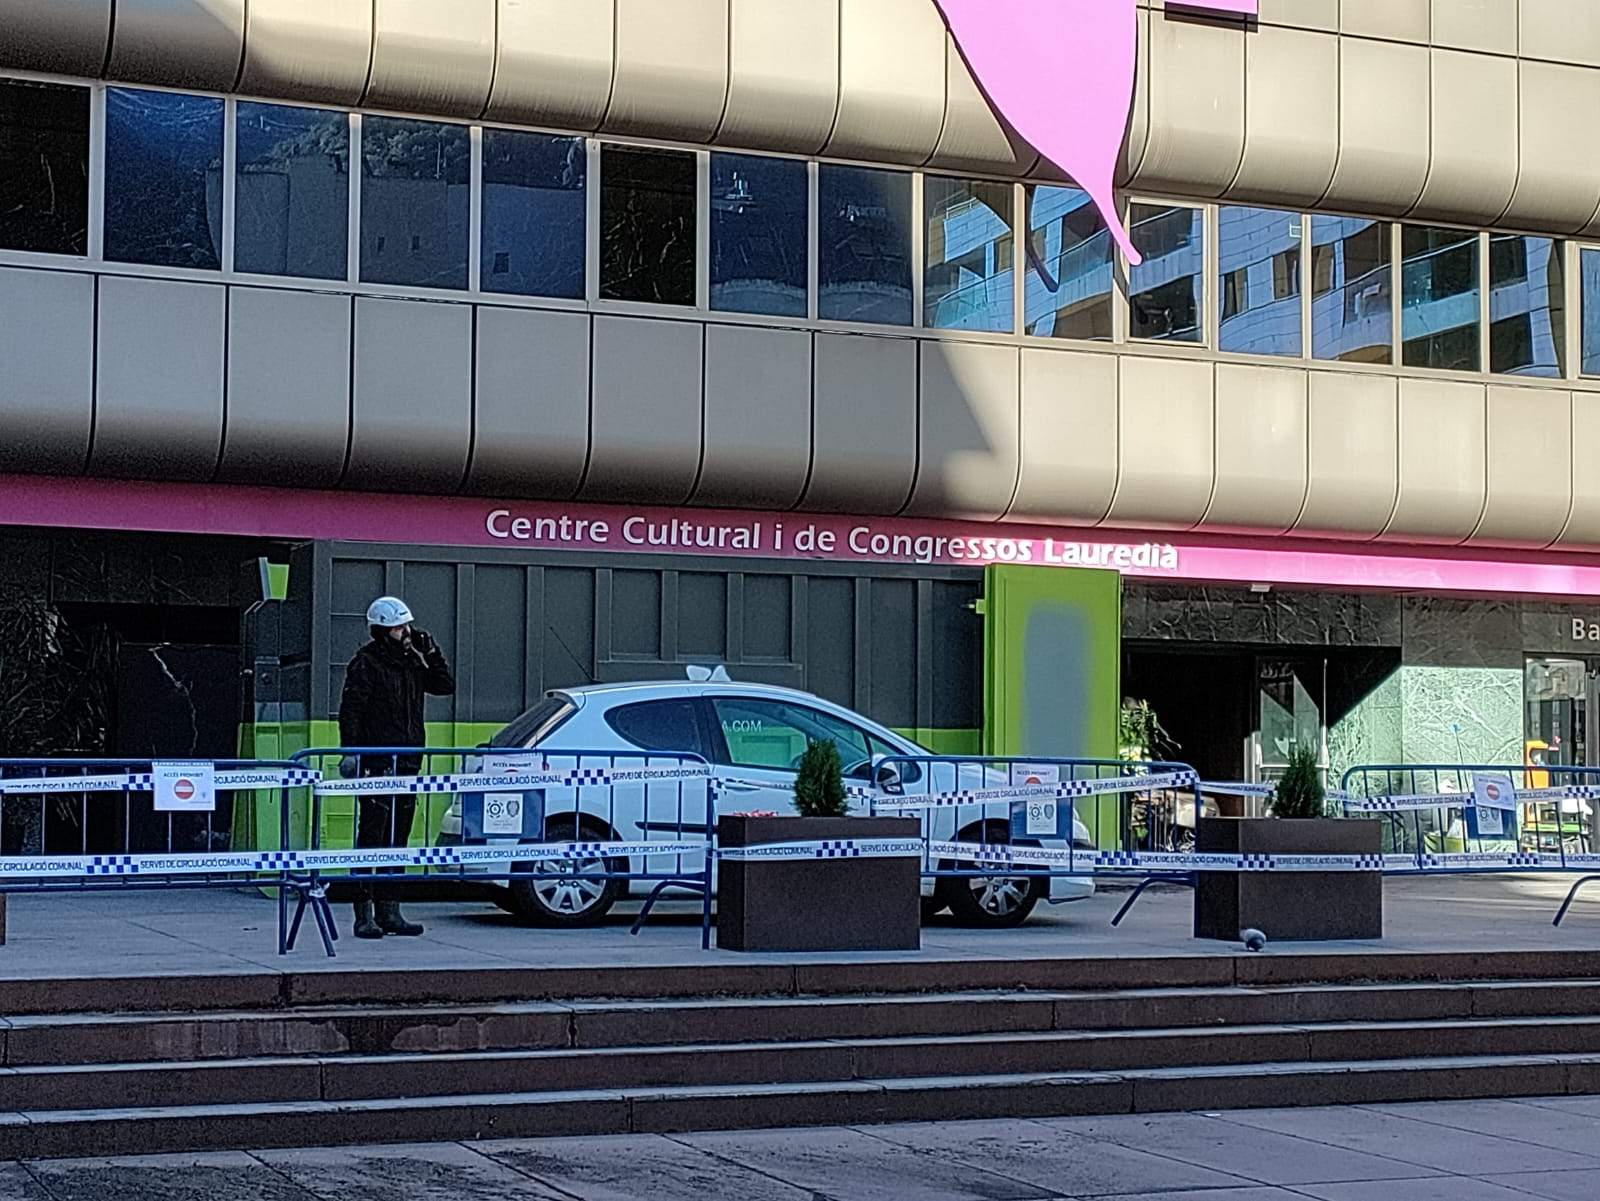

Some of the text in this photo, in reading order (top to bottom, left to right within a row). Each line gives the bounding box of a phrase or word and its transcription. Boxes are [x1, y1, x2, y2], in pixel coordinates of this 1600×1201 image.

[485, 509, 1178, 569] Centre Cultural i de Congressos Lauredià
[1572, 618, 1600, 641] Ba
[460, 777, 482, 786] SERVEI
[483, 777, 491, 785] DE
[48, 860, 84, 871] COMUNAL
[140, 860, 165, 869] SERVEI
[165, 859, 175, 869] DE
[218, 857, 252, 867] COMUNAL
[305, 856, 328, 865] SERVEI
[329, 855, 339, 864] DE
